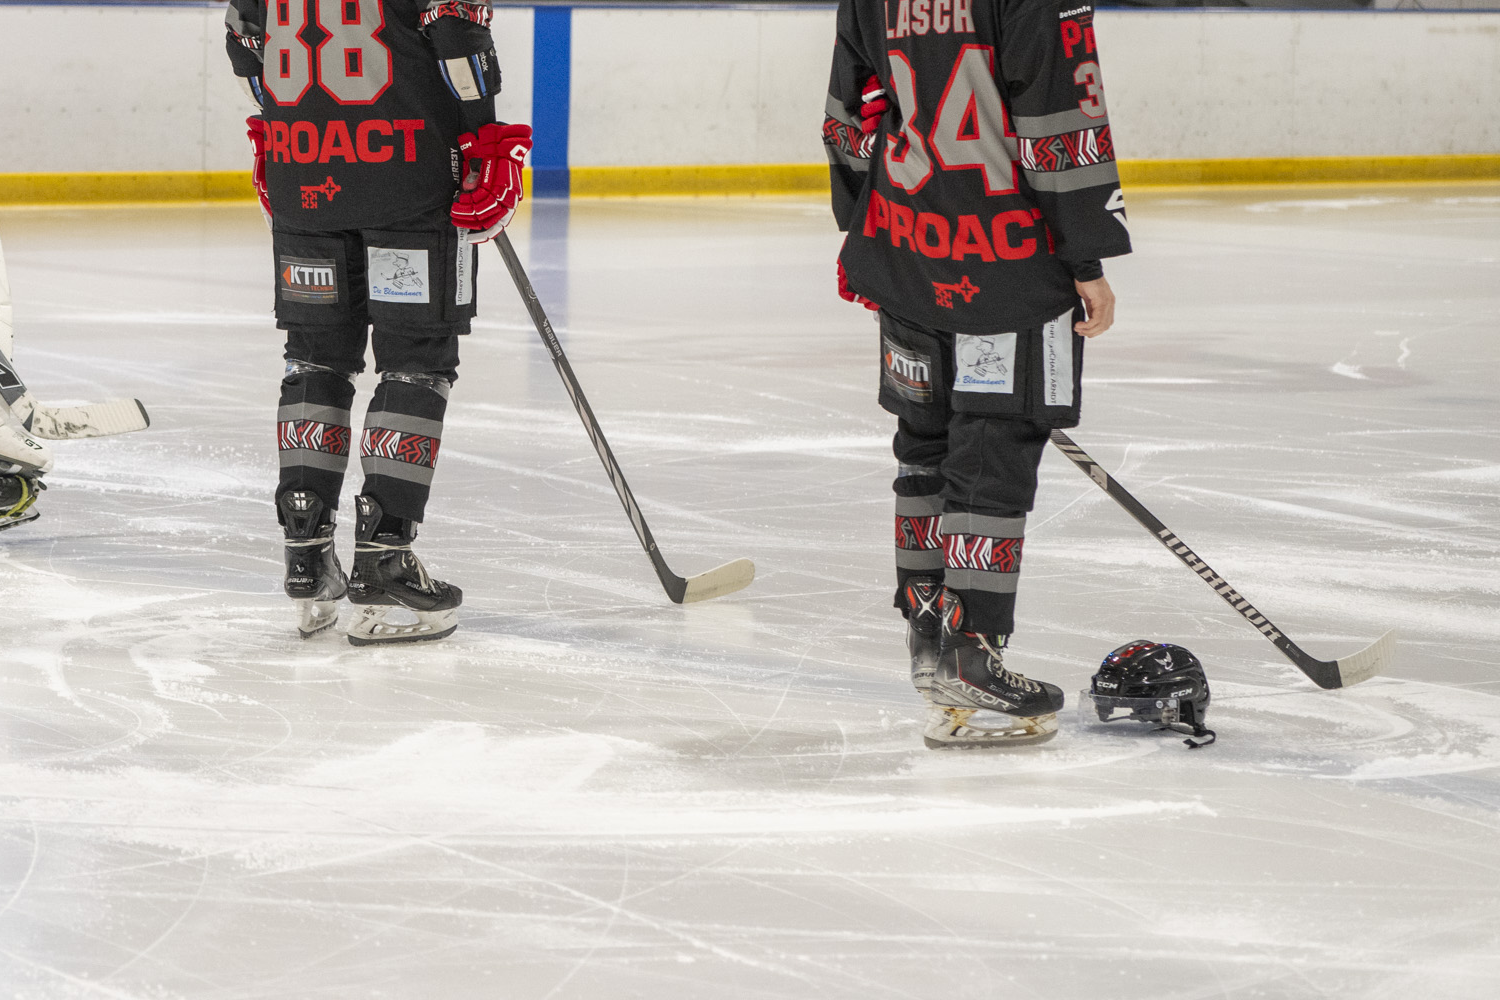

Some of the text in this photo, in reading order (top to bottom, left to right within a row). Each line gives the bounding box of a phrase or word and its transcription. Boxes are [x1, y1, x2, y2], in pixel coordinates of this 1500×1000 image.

[883, 44, 1021, 197] 34
[263, 119, 425, 164] PROACT
[290, 265, 334, 286] KTM
[544, 326, 562, 357] BAUER
[945, 670, 1018, 711] VAPOR
[1096, 681, 1118, 689] CCM
[1170, 688, 1193, 698] CCM
